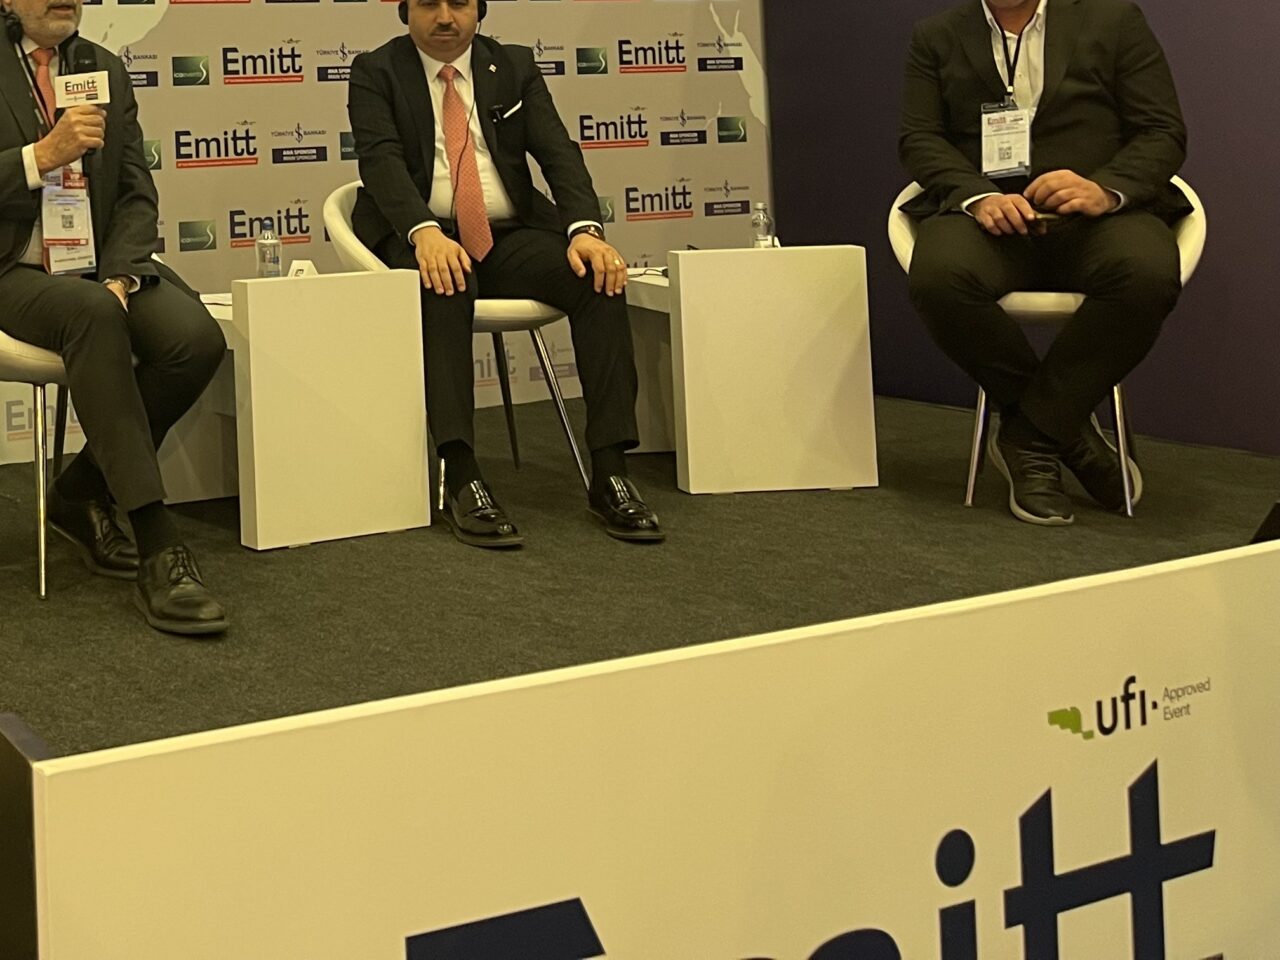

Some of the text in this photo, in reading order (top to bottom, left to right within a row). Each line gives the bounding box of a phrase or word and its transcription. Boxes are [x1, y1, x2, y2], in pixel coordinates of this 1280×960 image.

[222, 46, 304, 77] Emitt
[618, 39, 686, 66] Emitt
[579, 113, 648, 142] Emitt
[175, 127, 258, 160] Emitt
[624, 184, 693, 214] Emitt
[1162, 677, 1211, 702] Approved
[1163, 703, 1192, 721] Event
